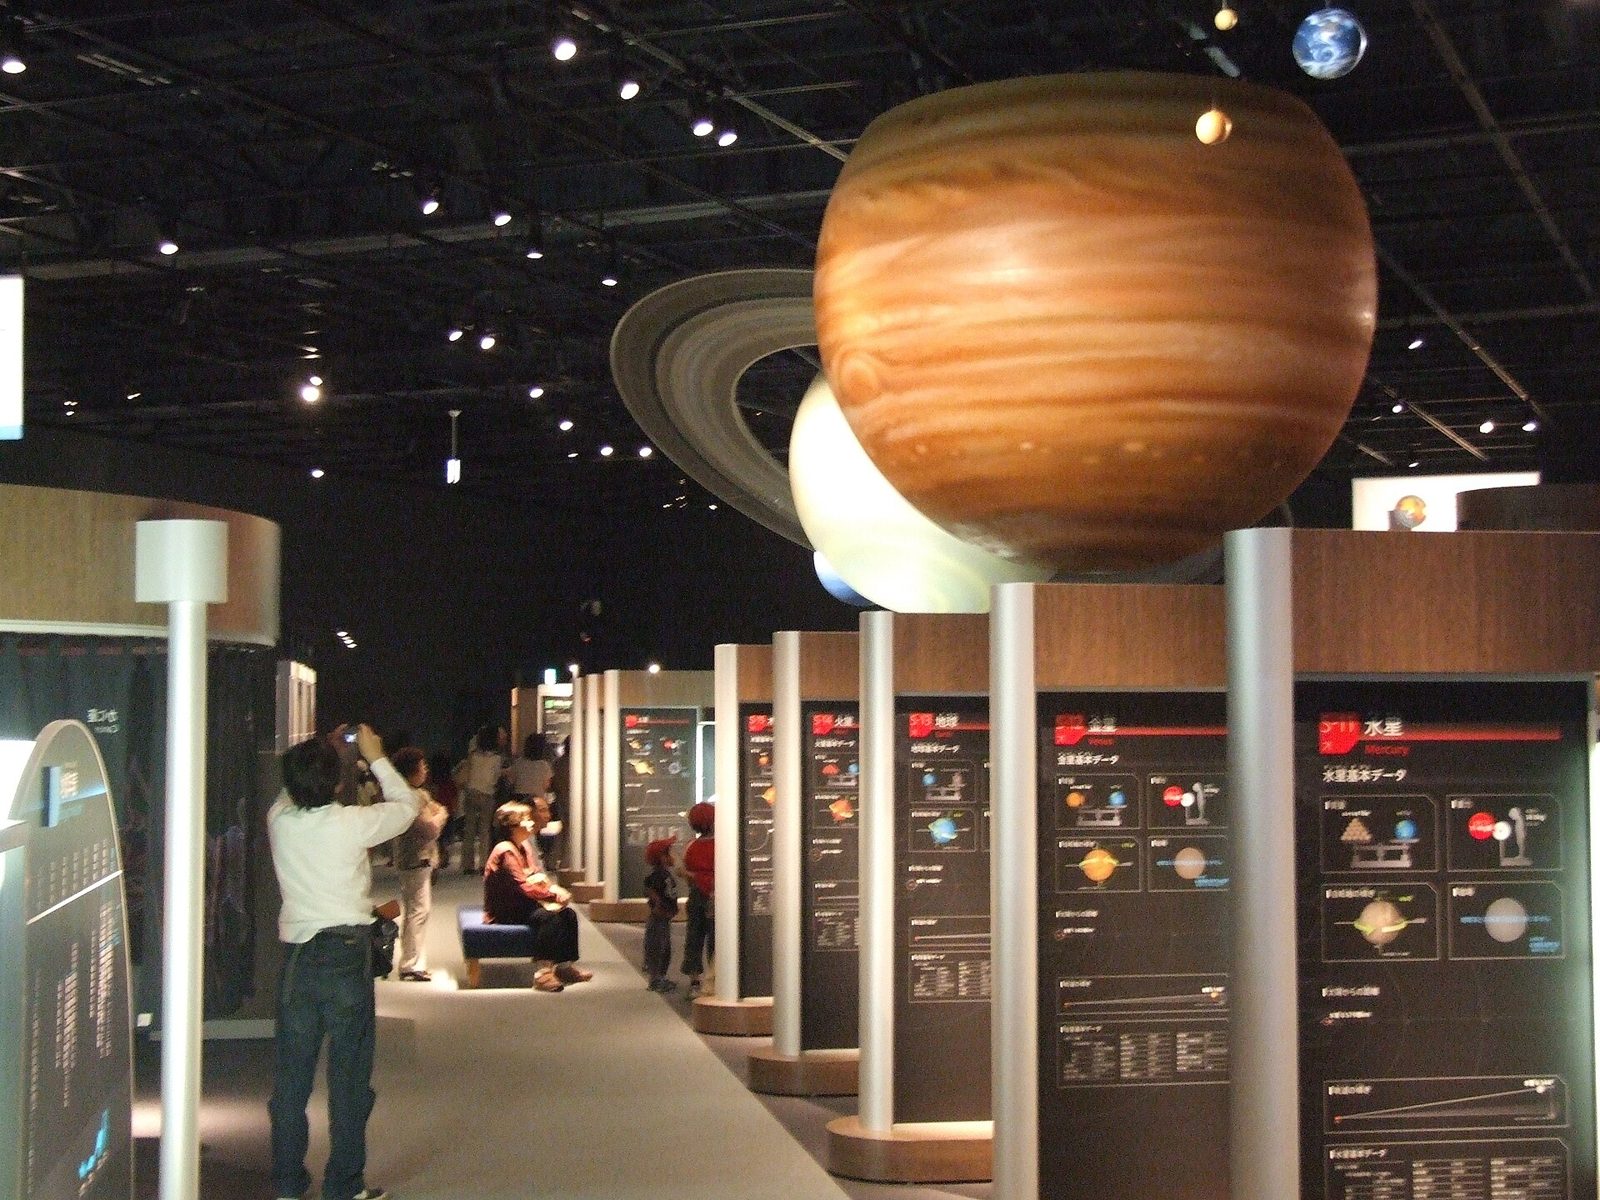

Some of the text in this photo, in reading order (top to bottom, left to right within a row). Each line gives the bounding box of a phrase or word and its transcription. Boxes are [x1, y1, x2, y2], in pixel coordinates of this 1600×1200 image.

[935, 713, 960, 728] 地球
[1088, 717, 1117, 733] 金星
[1364, 717, 1405, 737] 水星
[1365, 745, 1409, 757] Mercury
[1057, 754, 1120, 766] 金星基本データ
[1322, 768, 1407, 783] 水星基本データ
